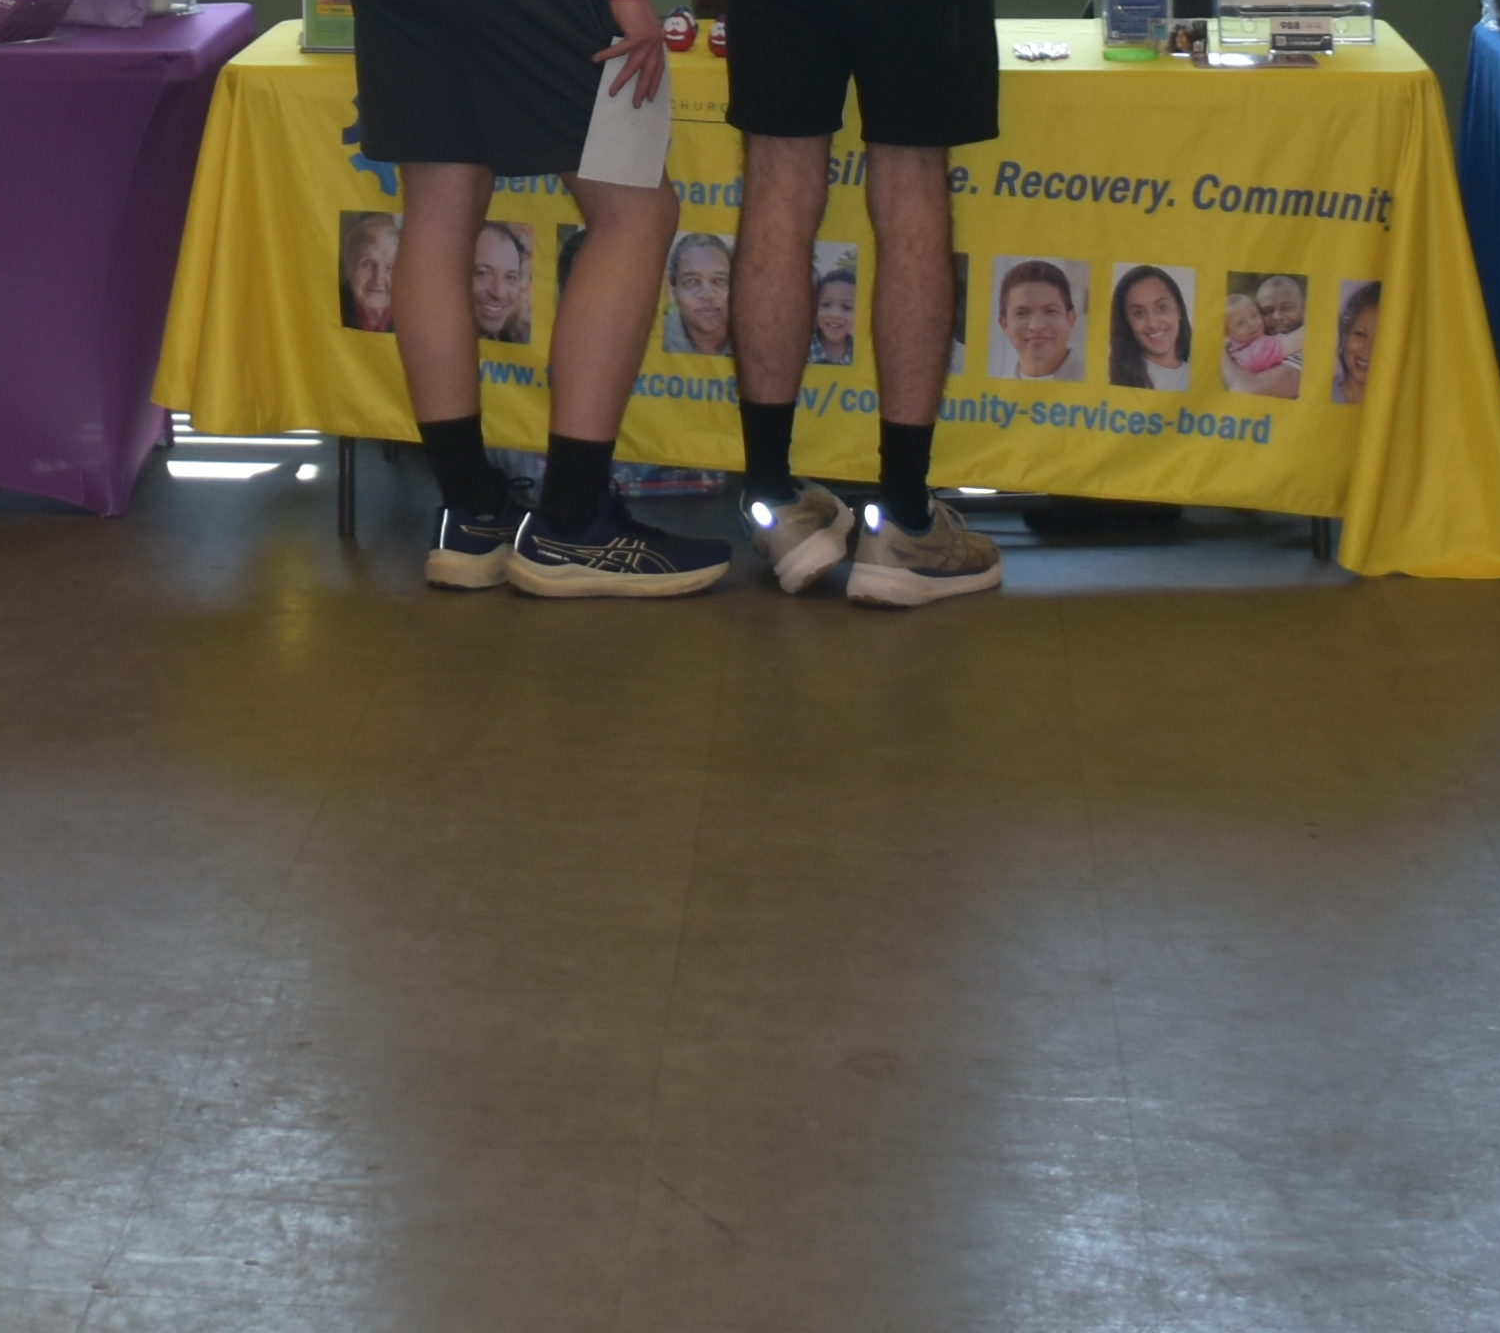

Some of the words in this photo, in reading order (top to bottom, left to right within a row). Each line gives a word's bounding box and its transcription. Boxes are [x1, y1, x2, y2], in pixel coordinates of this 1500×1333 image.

[1280, 20, 1301, 30] 988
[674, 177, 743, 207] oard
[994, 160, 1176, 214] Recovery.
